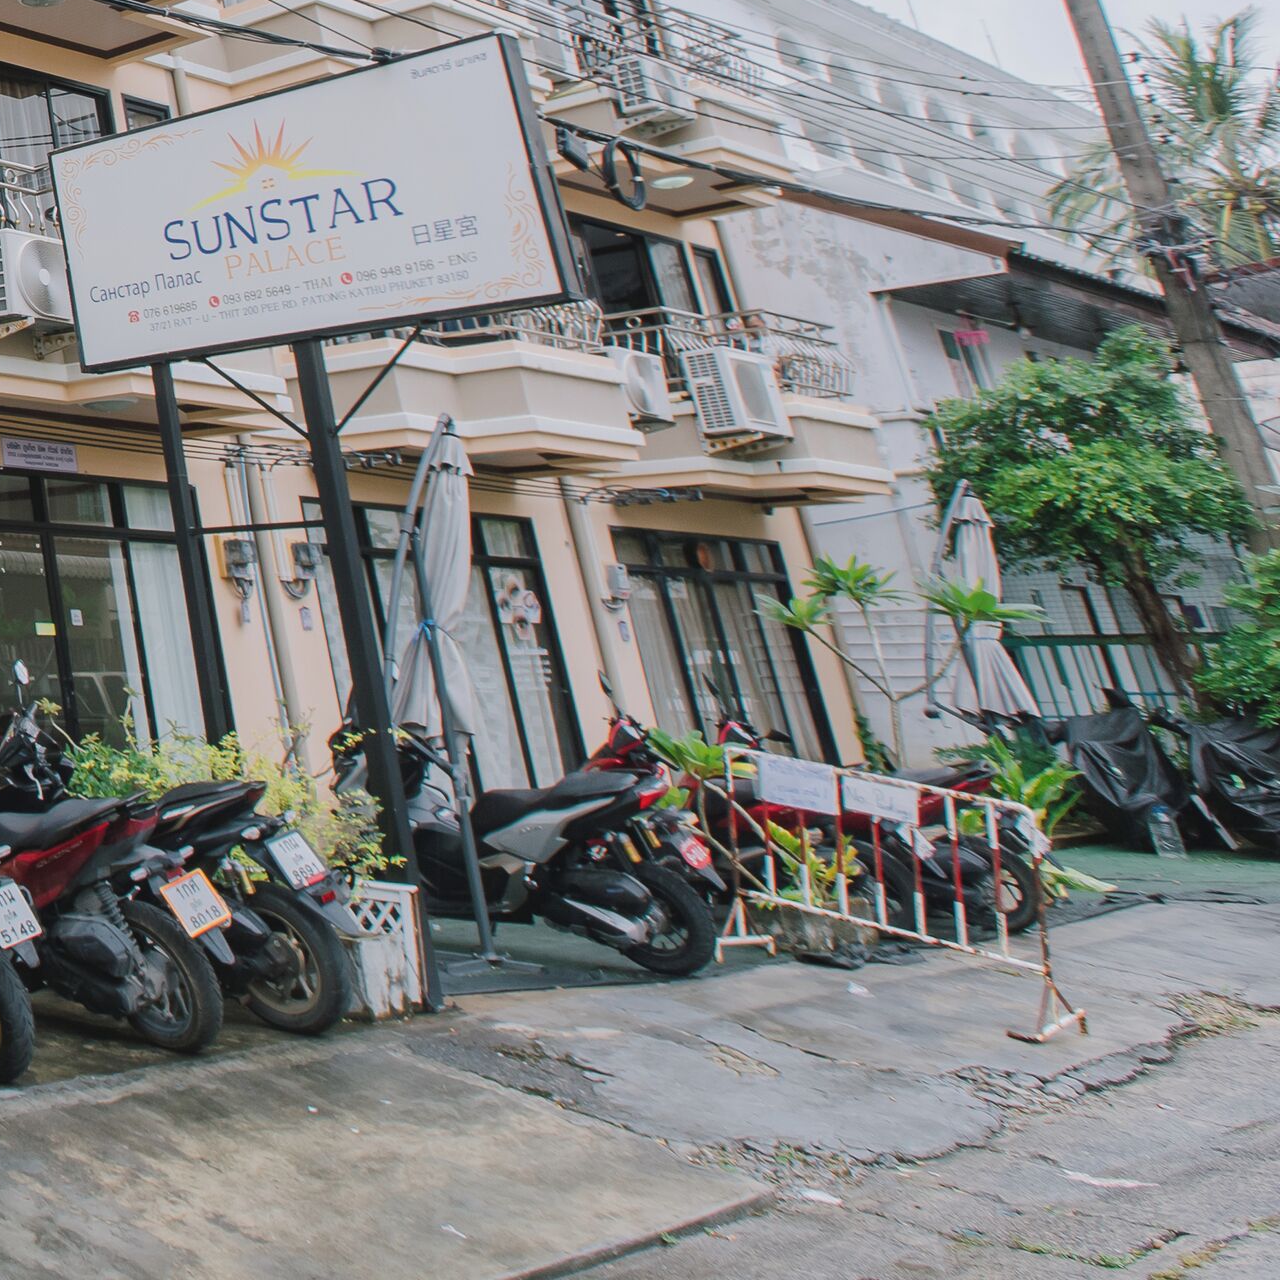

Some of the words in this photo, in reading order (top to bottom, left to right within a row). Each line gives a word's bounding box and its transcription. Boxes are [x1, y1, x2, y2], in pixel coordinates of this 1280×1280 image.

[163, 177, 404, 261] SUNSTAR
[411, 214, 478, 246] 日星宮
[223, 235, 347, 280] PALACE
[356, 269, 377, 282] 096
[380, 265, 401, 278] 948
[406, 259, 434, 274] 9156
[448, 251, 478, 266] ENG
[89, 279, 150, 303] Санстар
[154, 270, 203, 292] Палас
[173, 317, 193, 327] RAT
[243, 305, 259, 317] 200
[261, 302, 279, 313] PEE
[302, 292, 347, 307] PATONG
[349, 284, 386, 299] KATHU
[389, 276, 434, 292] PHUKET
[222, 293, 241, 305] 093
[244, 288, 262, 302] 692
[266, 284, 291, 297] 5649
[305, 276, 333, 291] THAI
[143, 306, 161, 319] 076
[0, 920, 37, 944] 5148
[190, 905, 221, 929] 8018
